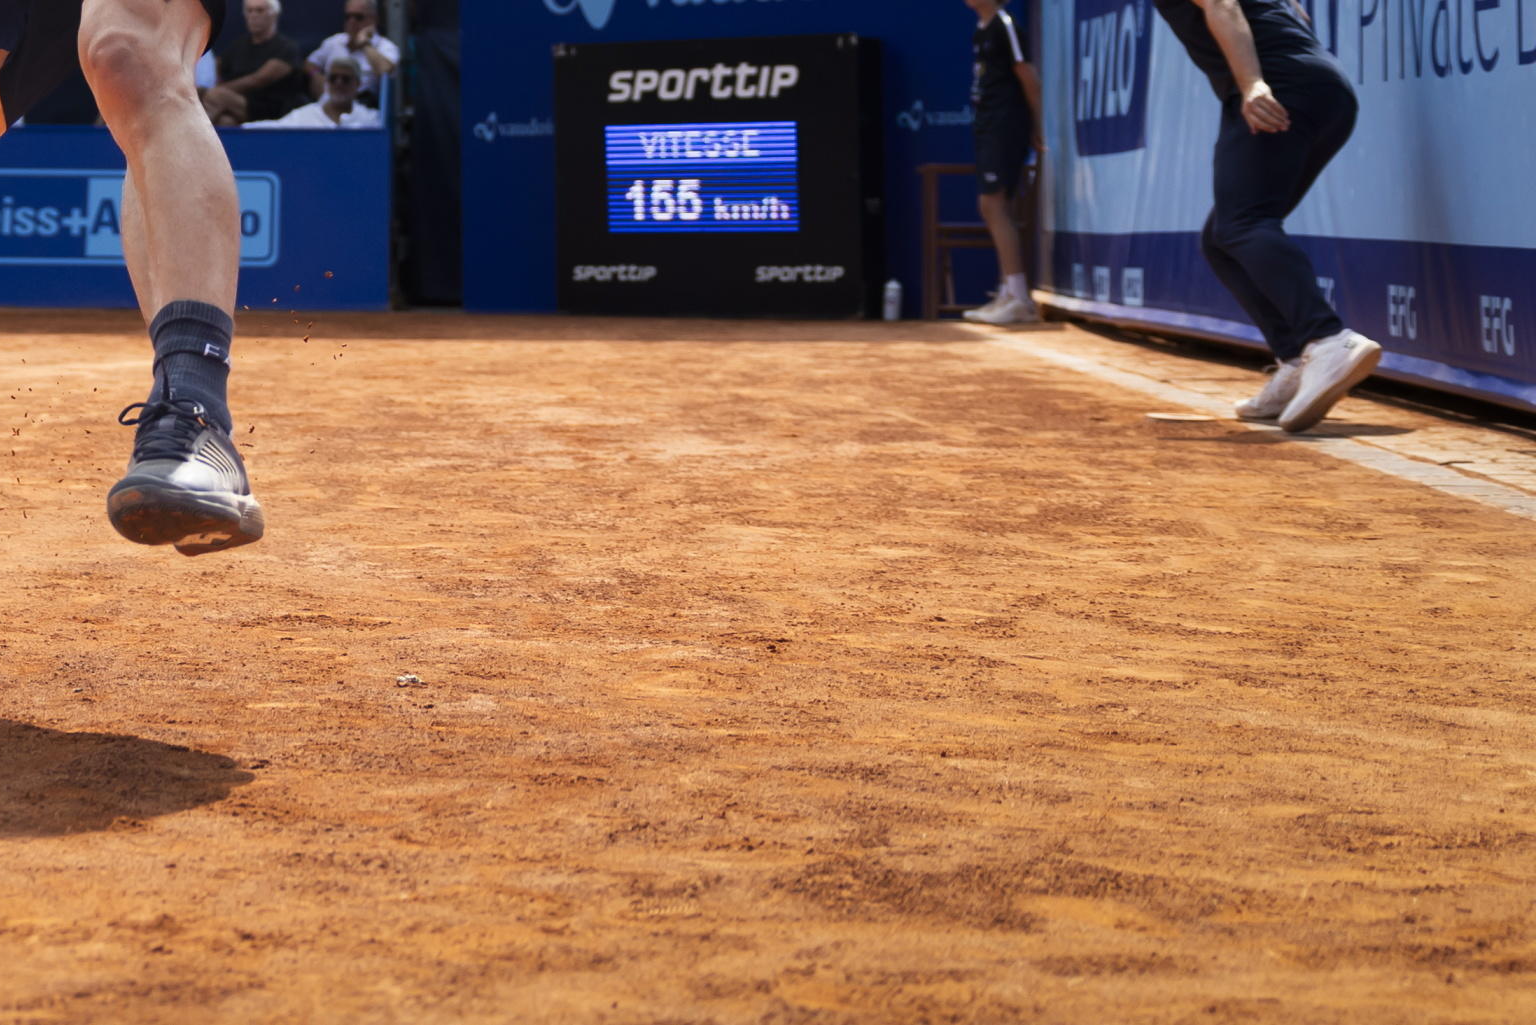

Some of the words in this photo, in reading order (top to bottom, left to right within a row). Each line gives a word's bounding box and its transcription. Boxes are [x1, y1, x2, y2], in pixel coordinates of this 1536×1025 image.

[638, 130, 759, 159] VITESSE
[1387, 283, 1417, 341] EFG
[1480, 294, 1516, 357] EFG
